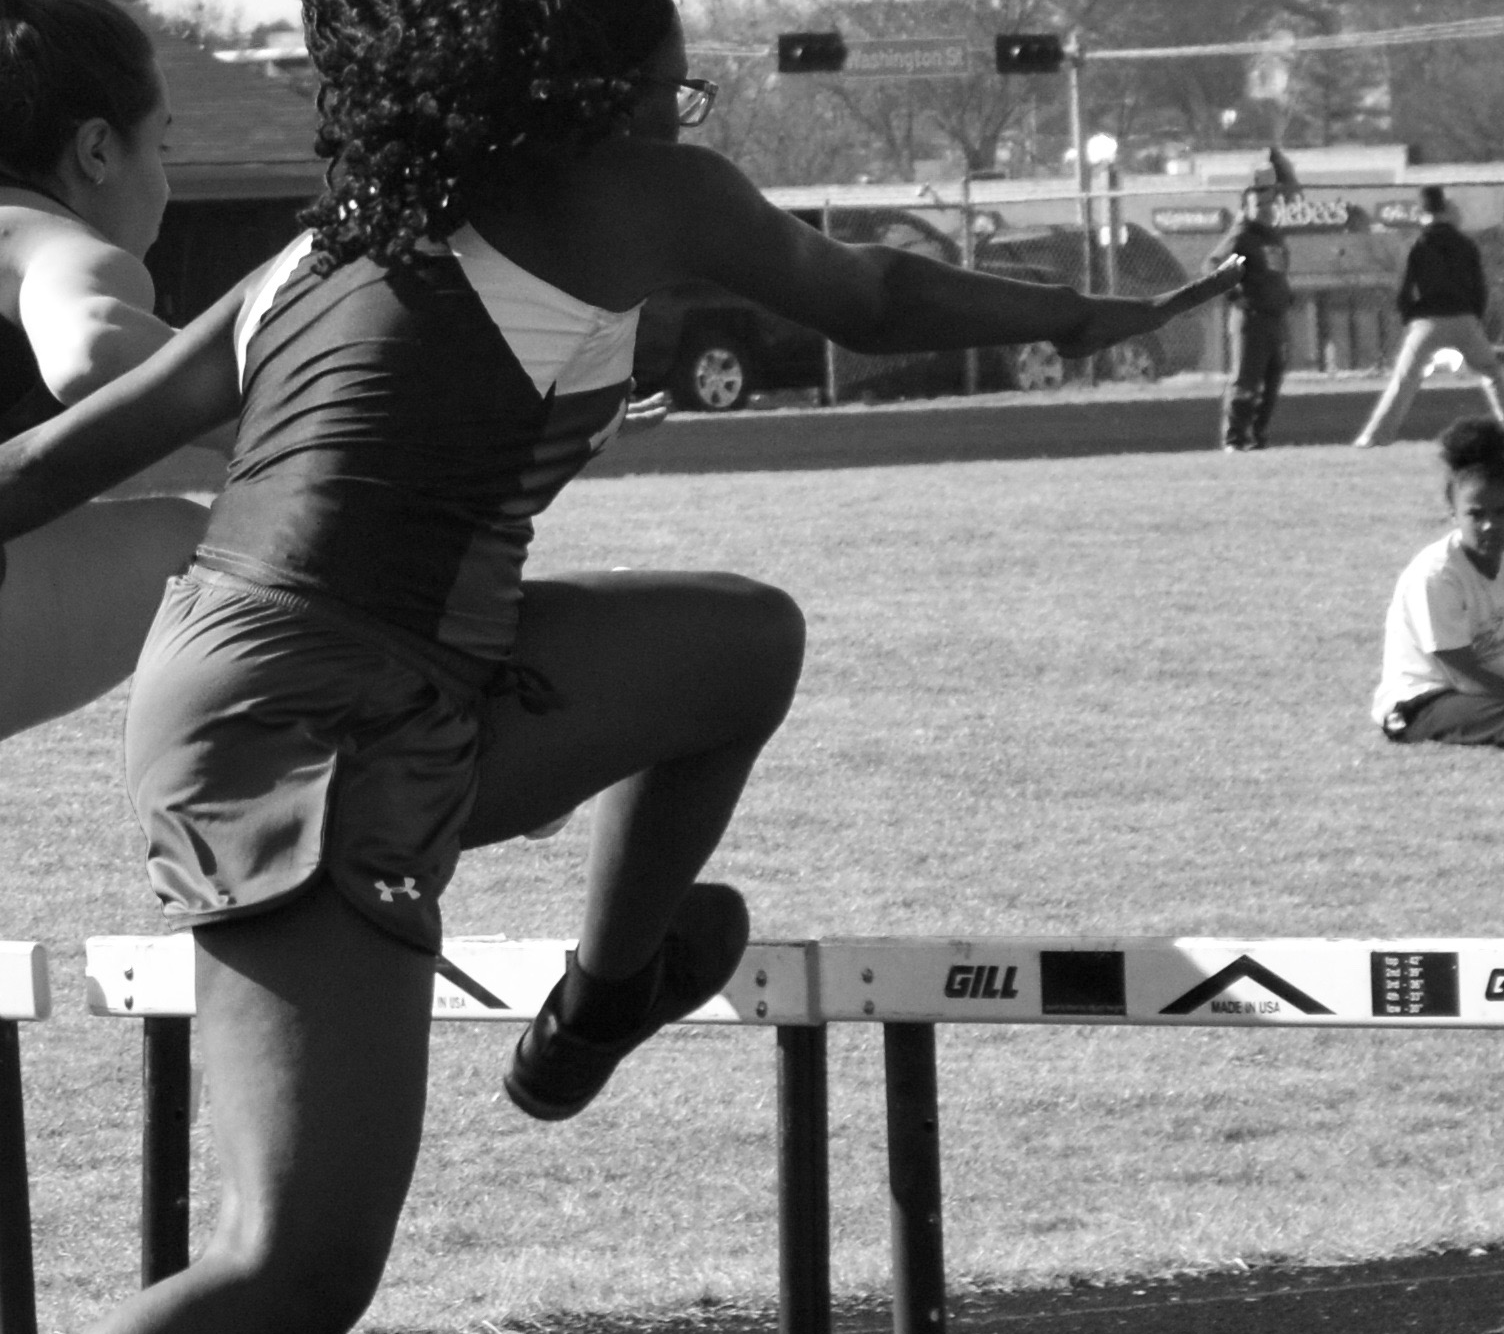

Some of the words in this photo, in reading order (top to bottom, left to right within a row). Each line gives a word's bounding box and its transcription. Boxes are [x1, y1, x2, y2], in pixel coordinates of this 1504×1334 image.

[845, 48, 944, 72] Washington
[943, 964, 1020, 1000] GILL
[1211, 1000, 1242, 1014] MADE
[1244, 1001, 1256, 1014] IN
[1259, 1001, 1281, 1014] USA
